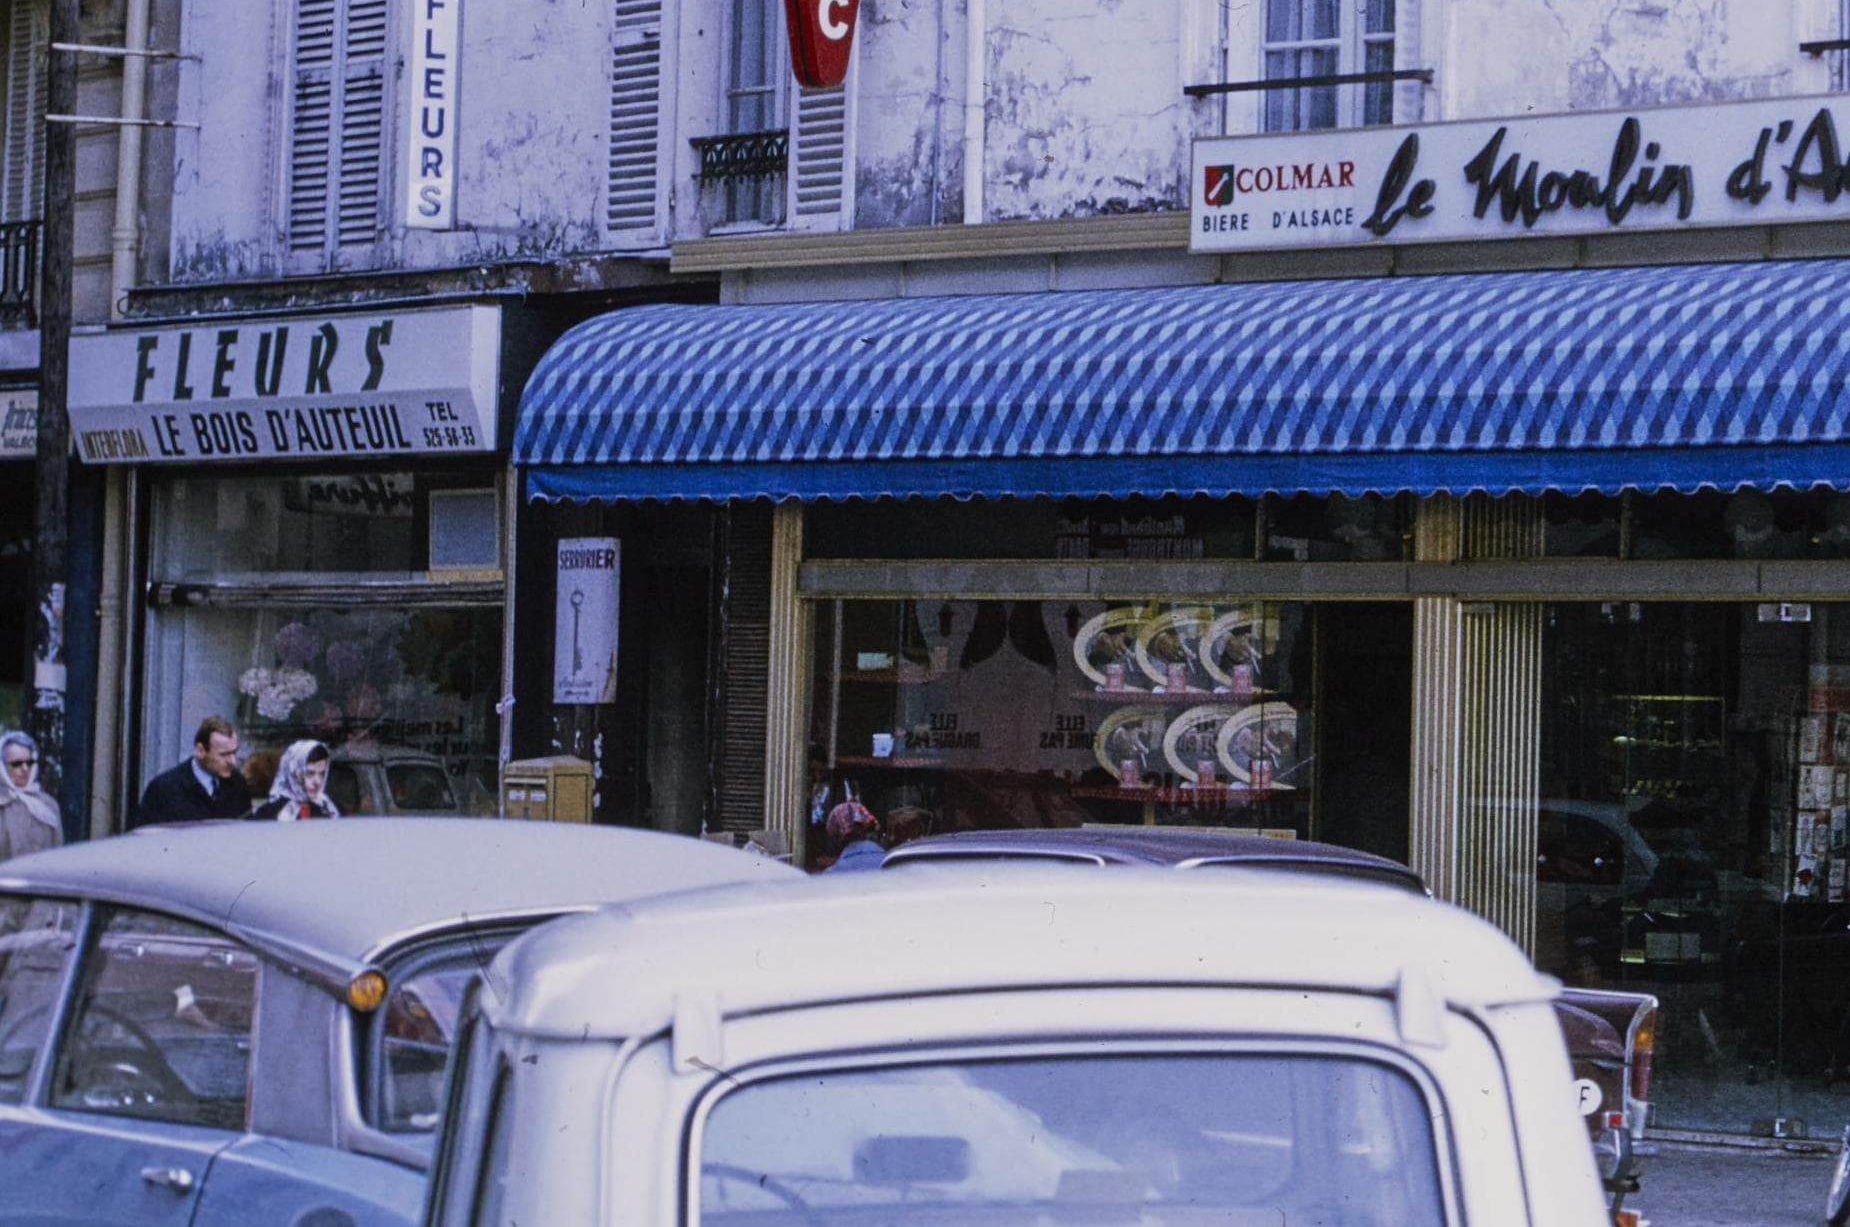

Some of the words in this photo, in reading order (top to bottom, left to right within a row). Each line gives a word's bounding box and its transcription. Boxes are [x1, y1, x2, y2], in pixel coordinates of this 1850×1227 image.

[1236, 161, 1355, 193] COLMAR
[1361, 132, 1436, 236] le
[1463, 116, 1694, 229] Moulin
[1203, 213, 1249, 233] BIERE
[1272, 208, 1354, 229] D'ALSACE
[132, 320, 393, 402] FLEURS
[151, 414, 185, 456] LE
[190, 410, 258, 455] BOIS
[265, 403, 412, 453] D'AUTEUIL
[425, 401, 459, 422] TEL
[559, 548, 616, 571] SERRURIER
